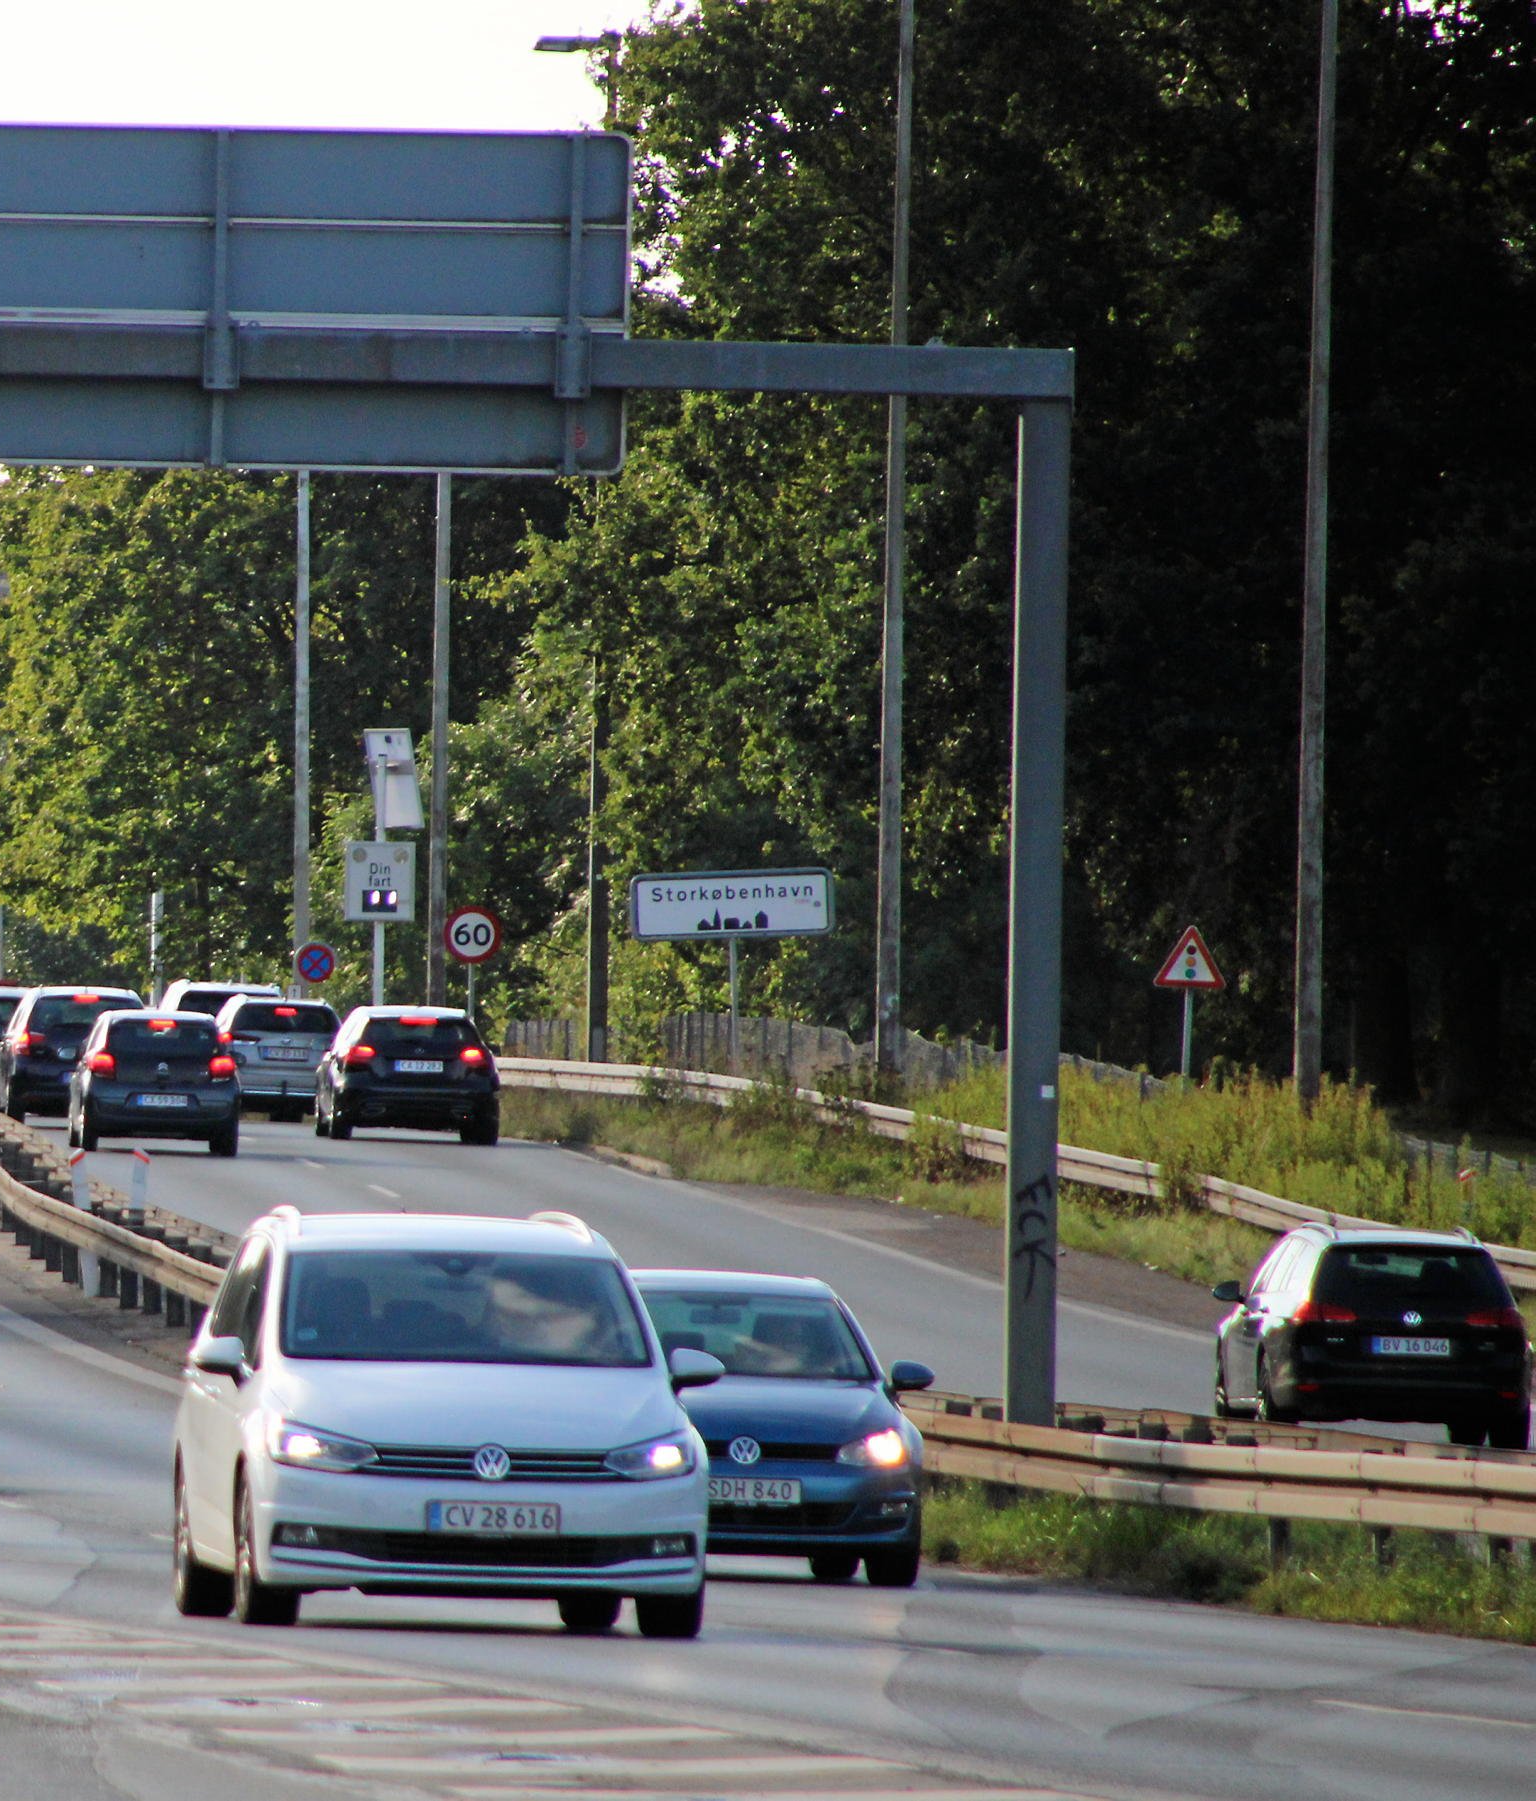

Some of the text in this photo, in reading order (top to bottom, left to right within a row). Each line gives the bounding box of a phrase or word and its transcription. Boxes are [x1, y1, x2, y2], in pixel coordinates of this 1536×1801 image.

[369, 863, 391, 874] Din
[368, 875, 391, 887] fart
[651, 884, 814, 902] Storkøbenhavn
[454, 923, 491, 946] 60
[1382, 1339, 1448, 1352] BV 16 046
[708, 1479, 792, 1500] SDH 840
[446, 1505, 554, 1529] CV 28 616
